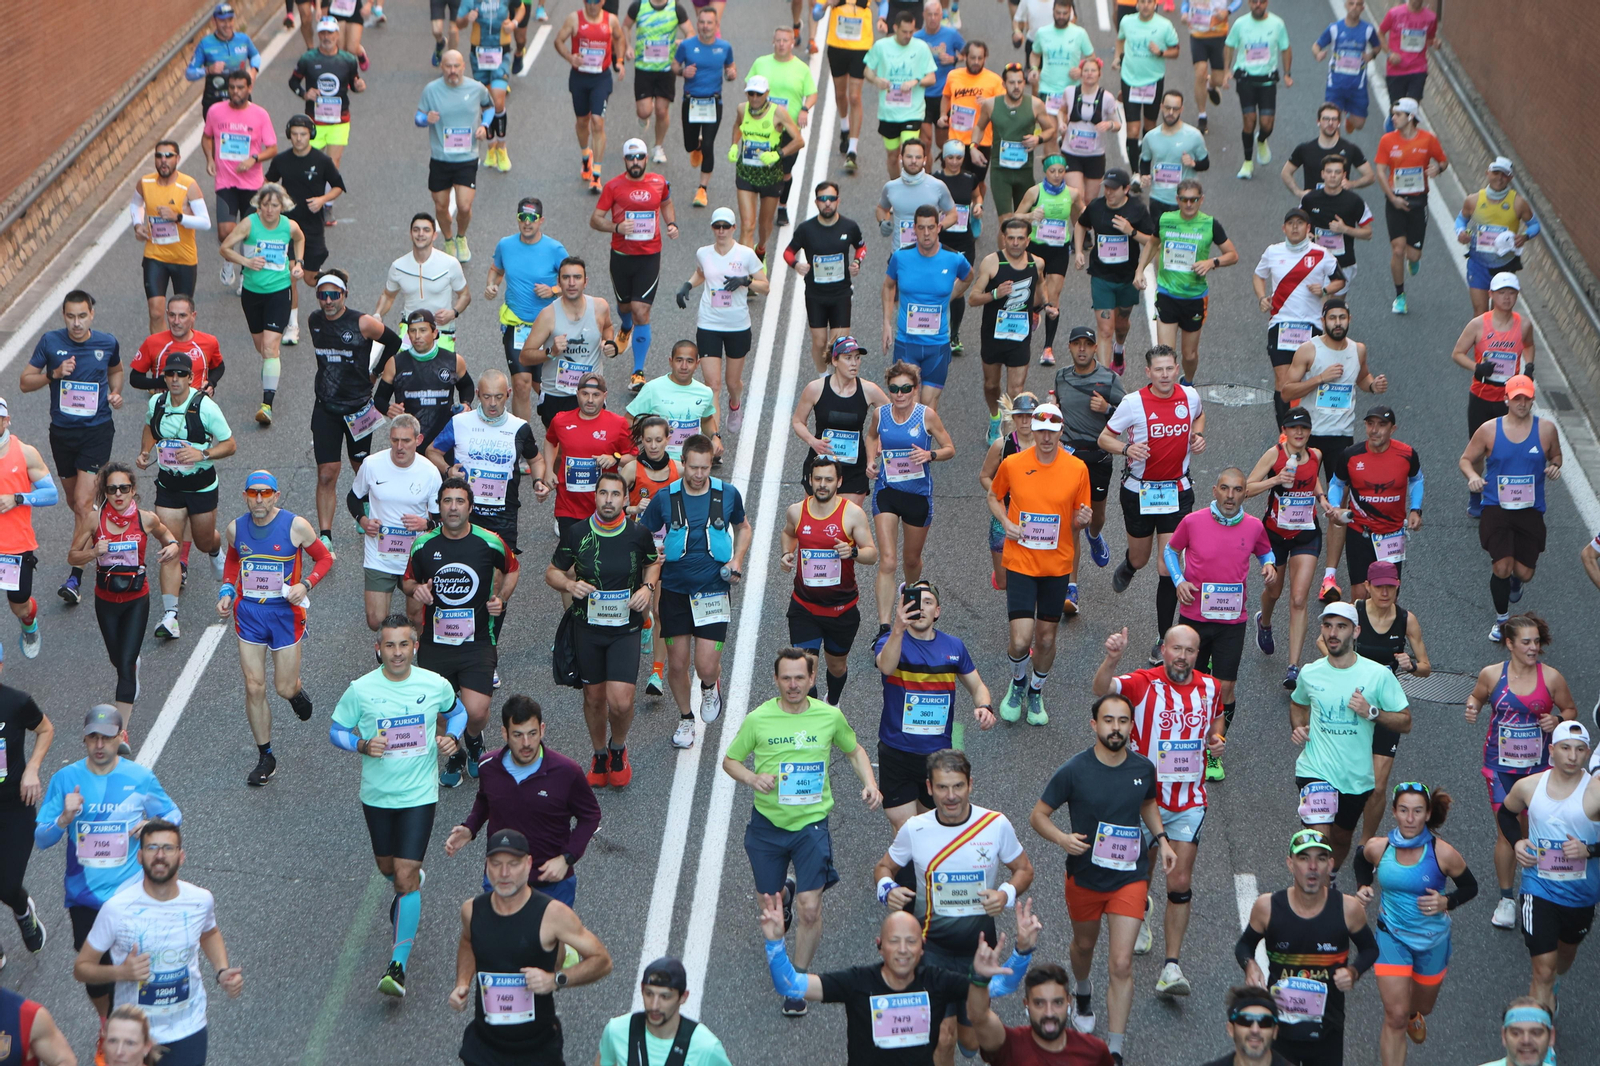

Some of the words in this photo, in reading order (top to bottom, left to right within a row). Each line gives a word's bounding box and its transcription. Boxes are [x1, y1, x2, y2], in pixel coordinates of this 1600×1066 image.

[954, 87, 983, 97] VAMOS
[1488, 340, 1516, 349] JAPAN
[404, 390, 427, 398] Grupeta
[427, 389, 449, 398] Running
[420, 397, 437, 406] Team
[469, 437, 514, 449] RUNNERS
[109, 543, 132, 552] ZURICH
[433, 576, 470, 585] Donando
[435, 583, 470, 593] Vidas
[393, 719, 420, 727] ZURICH
[390, 741, 418, 749] JUANFRAN
[88, 803, 135, 814] ZURICH
[1115, 829, 1138, 837] ZURICH
[951, 873, 979, 881] ZURICH
[158, 971, 186, 981] ZURICH
[495, 978, 525, 986] ZURICH
[1291, 980, 1320, 991] ZURICH
[155, 987, 176, 996] 12041
[892, 997, 922, 1005] ZURICH
